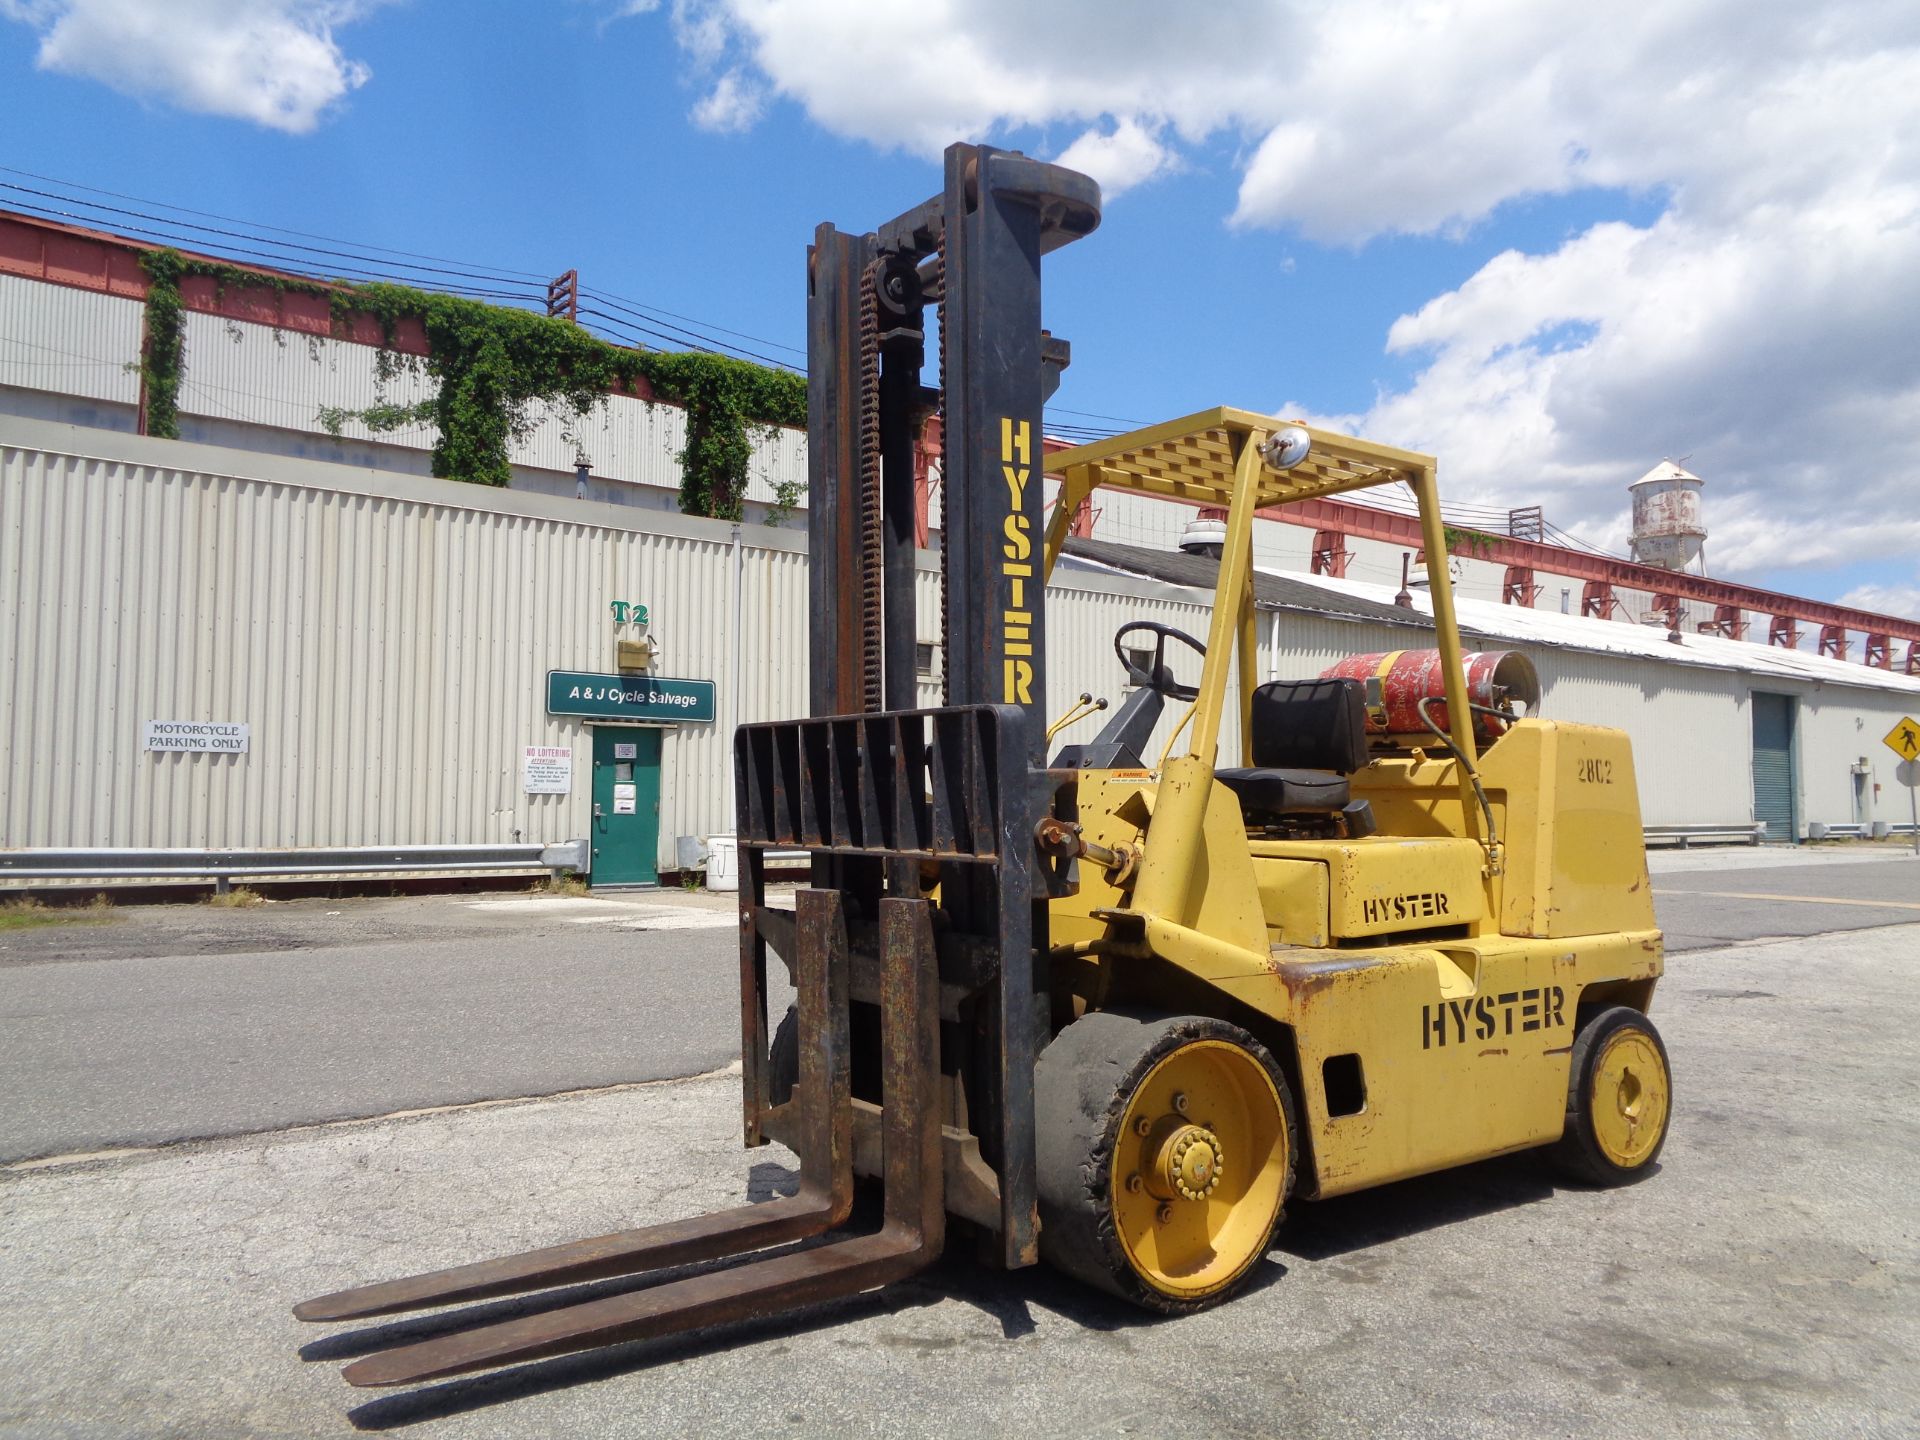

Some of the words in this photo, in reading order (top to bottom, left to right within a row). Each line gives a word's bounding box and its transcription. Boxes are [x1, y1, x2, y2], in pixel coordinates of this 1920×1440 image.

[1001, 417, 1033, 704] HYSTER
[610, 600, 649, 624] T2
[569, 686, 580, 699] A
[583, 687, 593, 700] &
[596, 688, 605, 700] J
[608, 688, 645, 704] Cycle
[648, 691, 697, 708] Salvage
[153, 724, 239, 736] MOTORCYCLE
[149, 737, 207, 748] PARKING
[211, 738, 244, 749] ONLY
[526, 748, 535, 757] NO
[538, 748, 571, 758] LOITERING
[1363, 891, 1450, 924] HYSTER
[1422, 985, 1565, 1049] HYSTER
